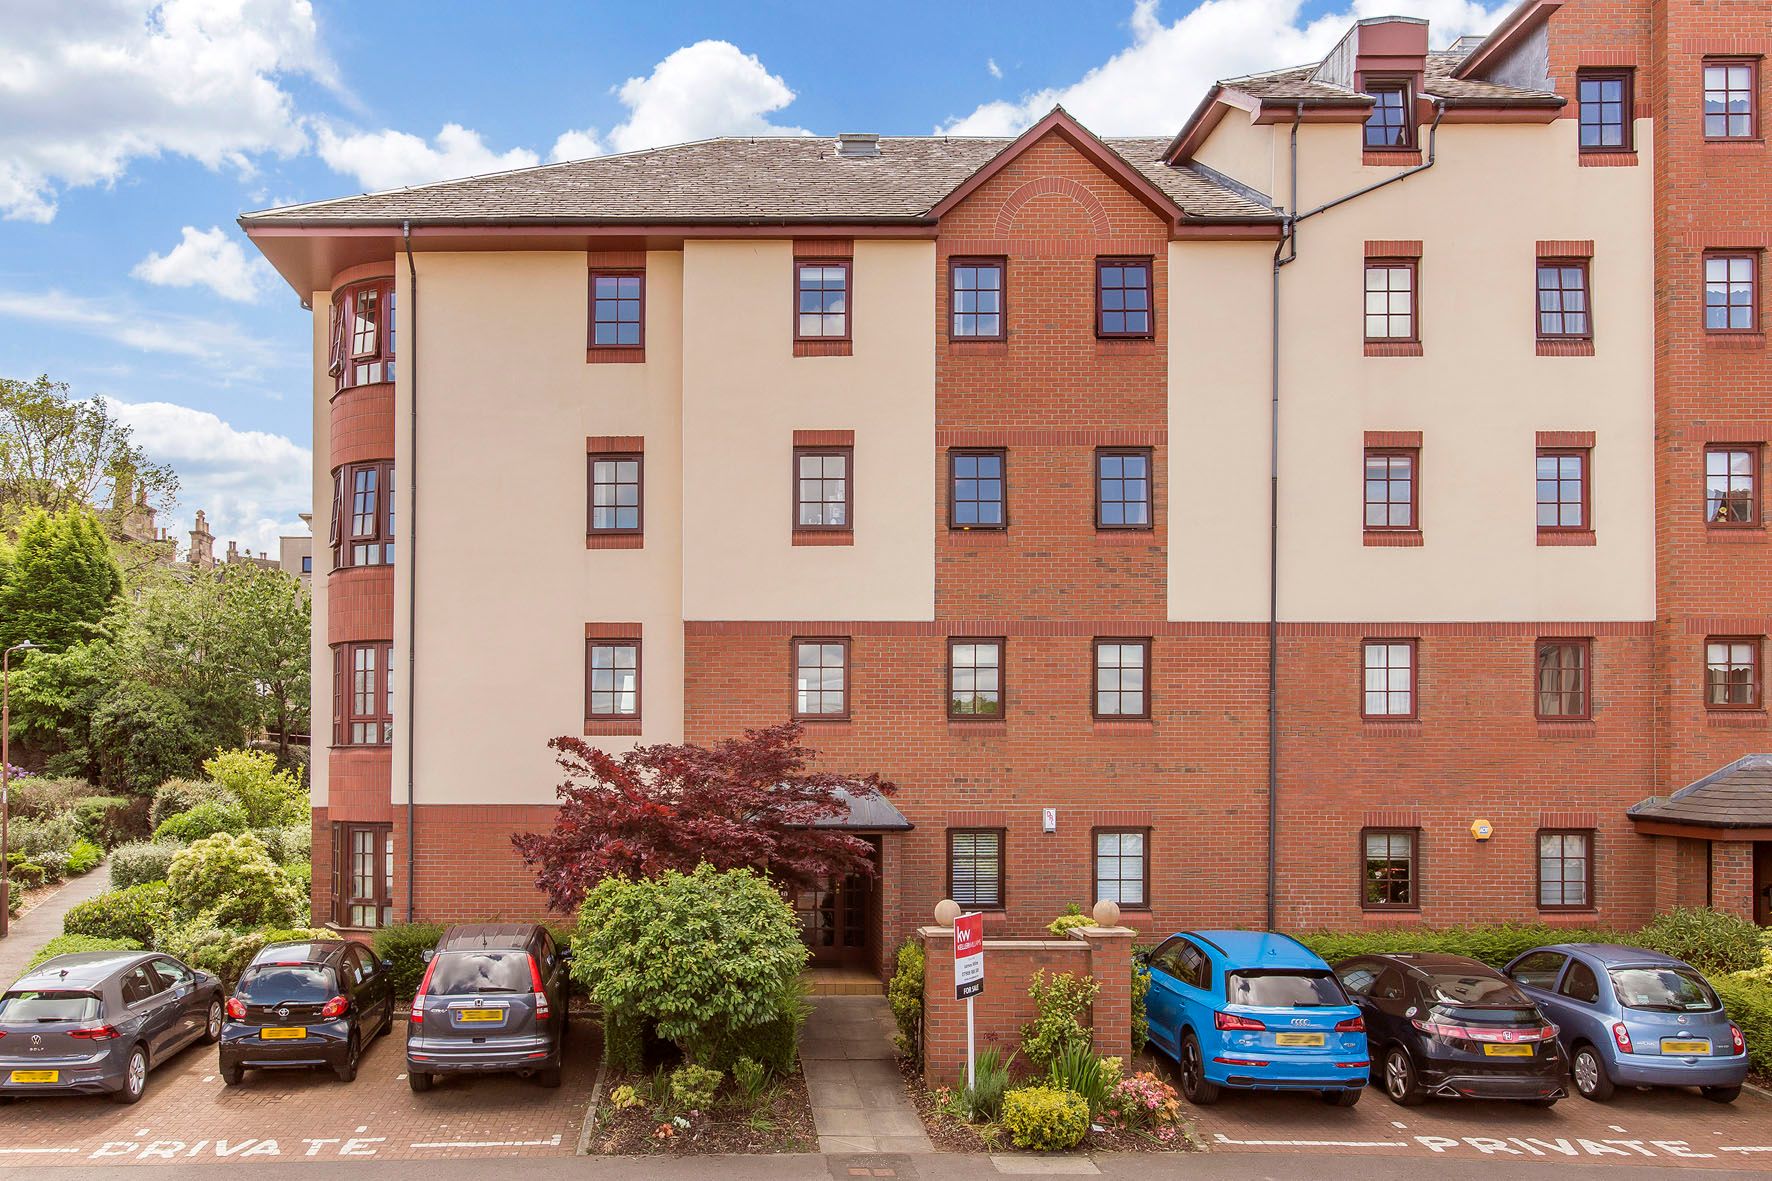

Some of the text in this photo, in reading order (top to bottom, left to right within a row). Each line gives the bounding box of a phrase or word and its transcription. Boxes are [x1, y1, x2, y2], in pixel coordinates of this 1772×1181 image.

[957, 926, 970, 943] kw
[971, 984, 979, 992] SALE
[1414, 1136, 1717, 1158] PRIVATE
